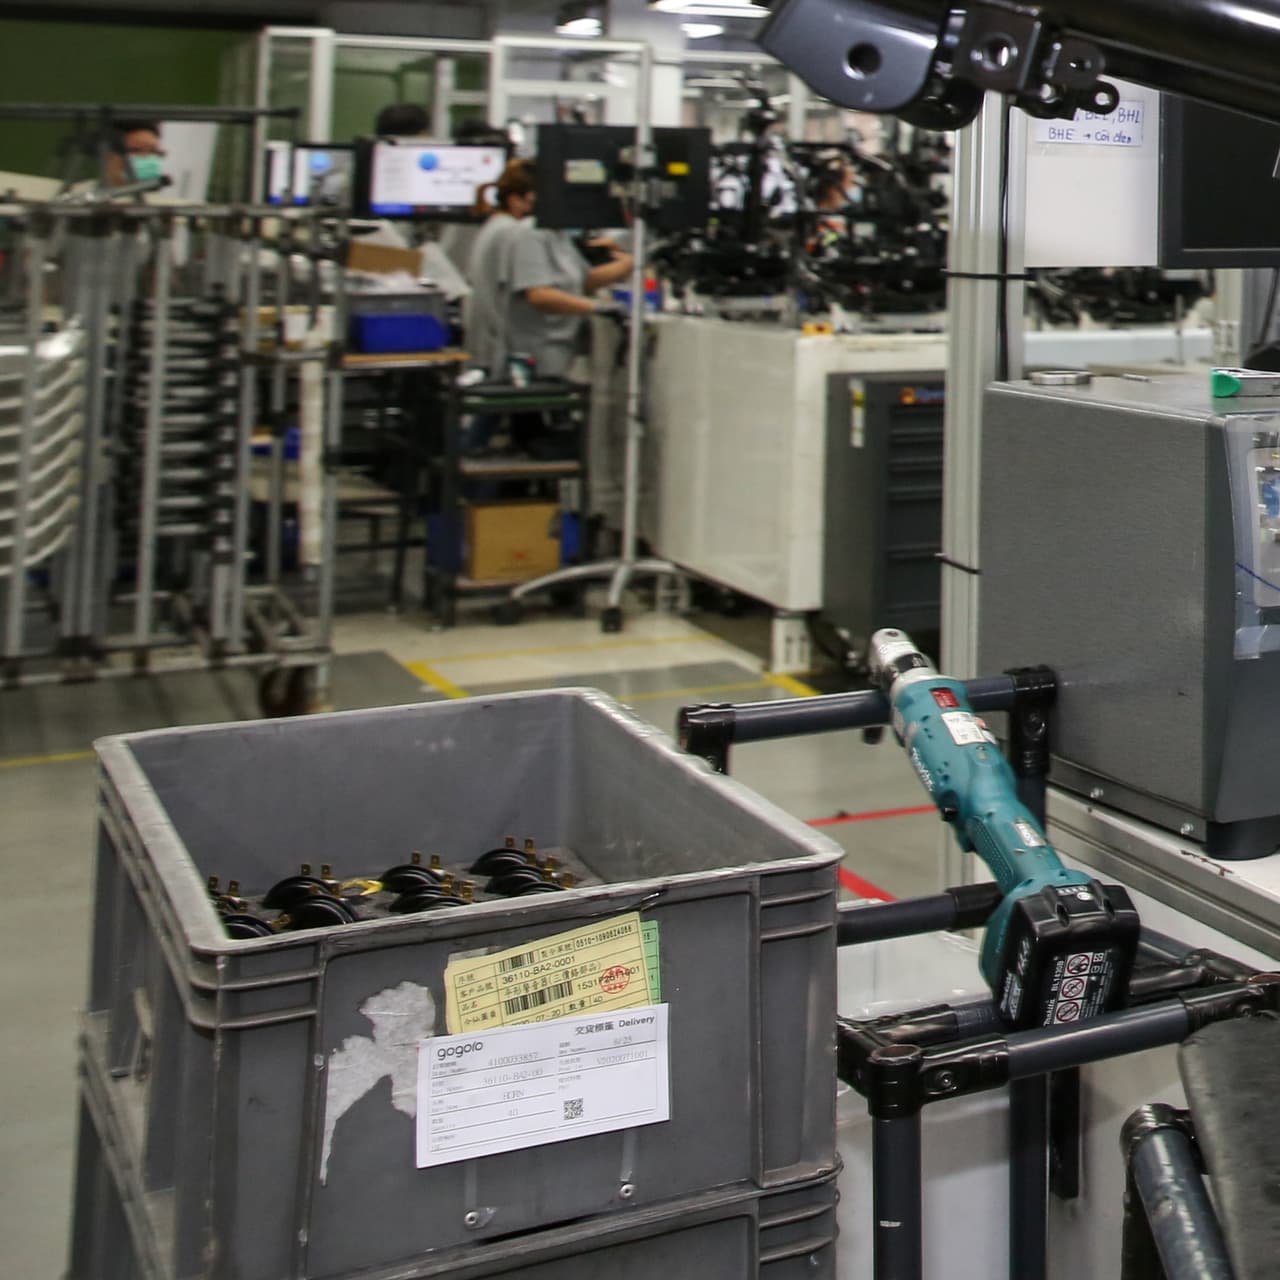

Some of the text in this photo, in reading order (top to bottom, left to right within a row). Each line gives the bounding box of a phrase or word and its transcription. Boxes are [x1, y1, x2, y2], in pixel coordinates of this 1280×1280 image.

[1048, 127, 1075, 140] BHE
[502, 956, 576, 985] 36110-BA2-0001
[568, 999, 586, 1011] 數量
[618, 1015, 655, 1028] Delivery
[437, 1041, 484, 1061] gogoro
